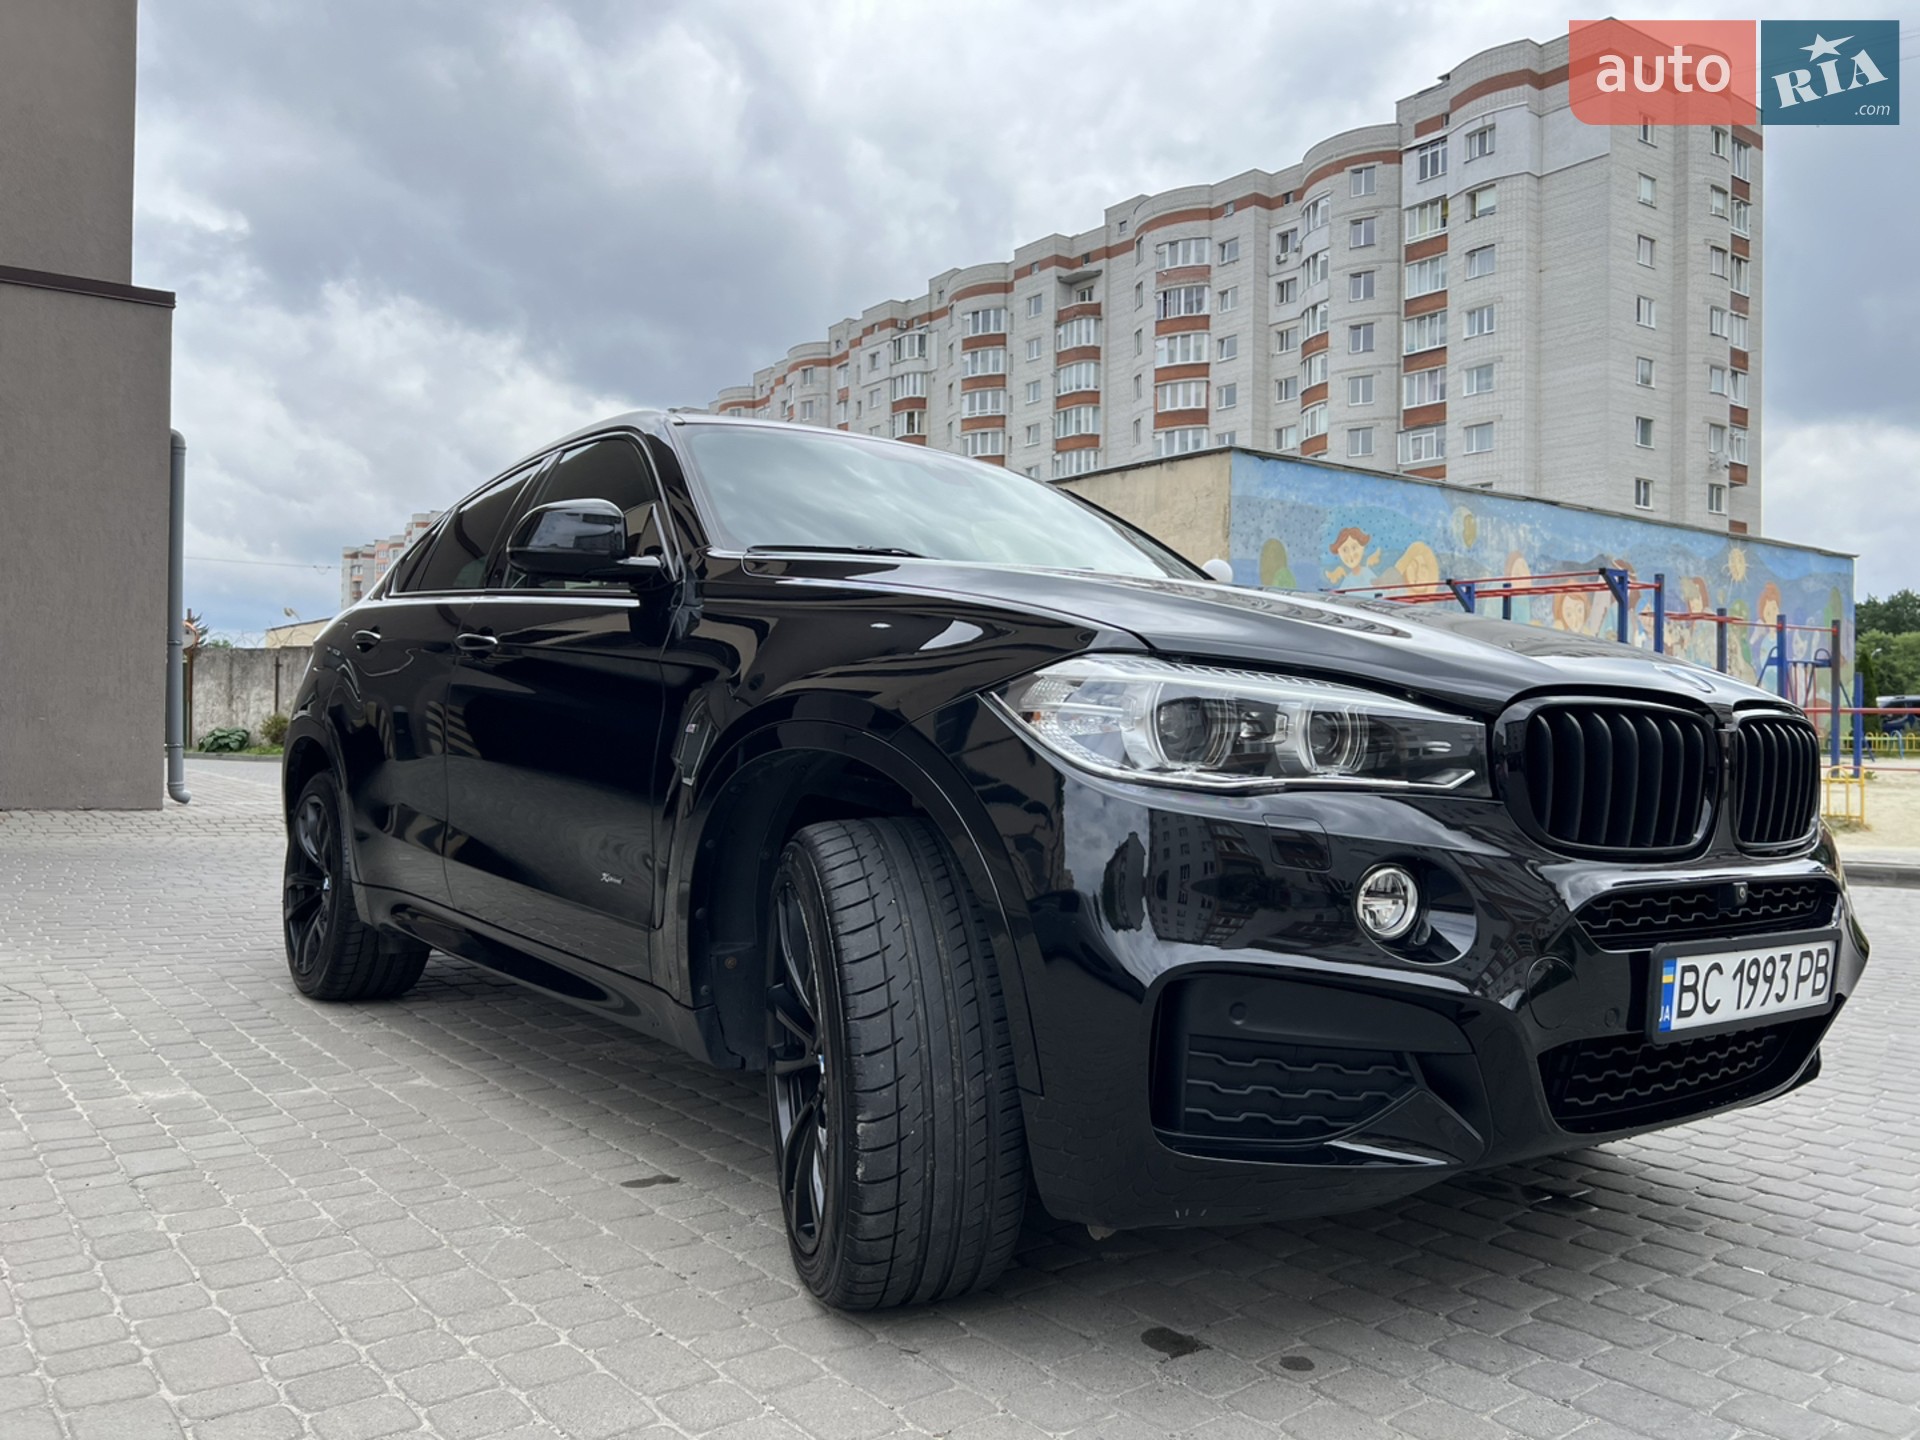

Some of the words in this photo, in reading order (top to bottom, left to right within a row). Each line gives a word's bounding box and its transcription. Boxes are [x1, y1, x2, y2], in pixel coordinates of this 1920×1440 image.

[1676, 962, 1724, 1019] BC
[1732, 953, 1793, 1011] 1993
[1794, 947, 1830, 1001] PB
